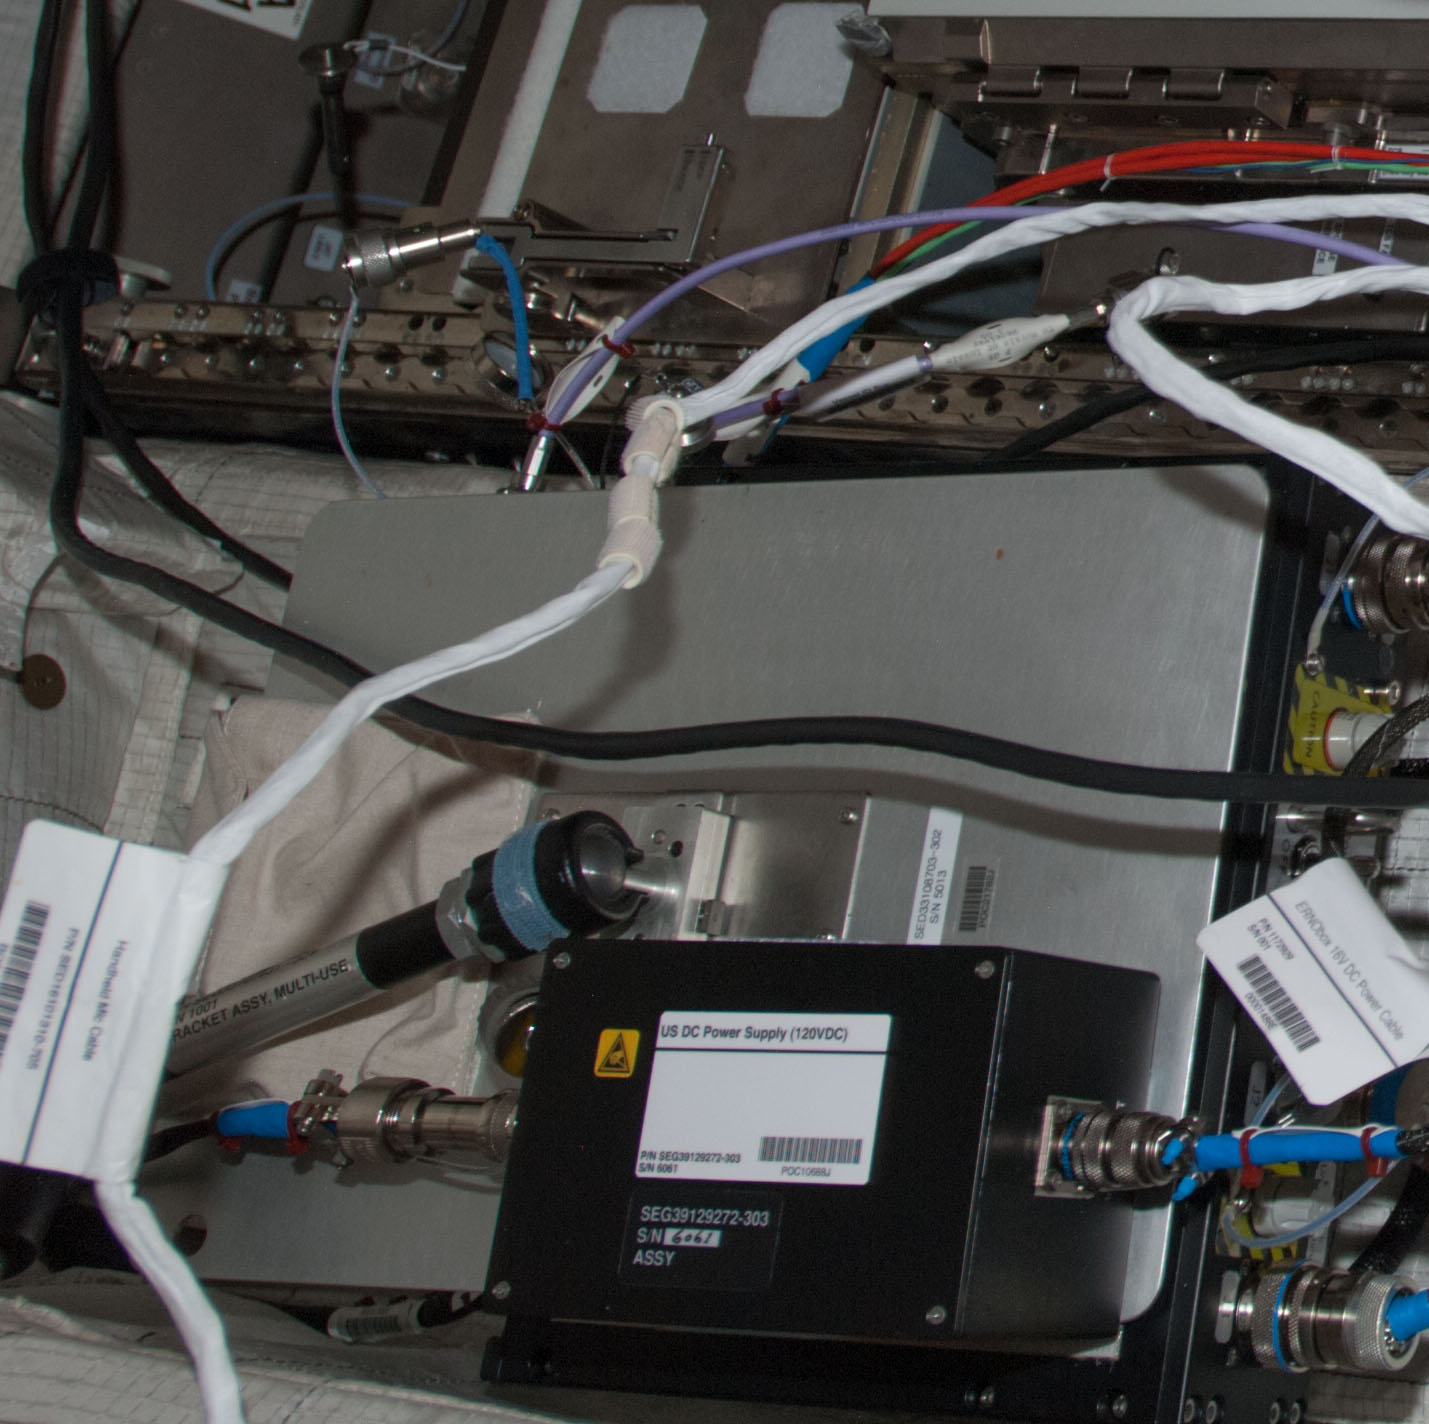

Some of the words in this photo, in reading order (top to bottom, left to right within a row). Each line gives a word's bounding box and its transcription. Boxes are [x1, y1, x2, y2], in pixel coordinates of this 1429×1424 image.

[1303, 689, 1321, 758] CAUTION
[933, 868, 947, 898] 5013
[928, 902, 941, 924] S/N
[1256, 915, 1274, 933] P/N
[61, 926, 80, 953] P/N
[1245, 921, 1263, 940] S/N
[1254, 934, 1273, 953] 001
[96, 938, 128, 1001] Handheld
[1292, 897, 1338, 949] ERNObox
[1340, 961, 1364, 985] DC
[1352, 978, 1386, 1014] Power
[1375, 1007, 1408, 1043] Cable
[170, 1008, 229, 1042] RACKET
[229, 990, 272, 1018] ASSY,
[271, 957, 351, 1000] MULTI-USE
[90, 1000, 110, 1025] Mic
[79, 1023, 103, 1063] Cable
[661, 1026, 678, 1039] US
[681, 1026, 700, 1039] DC
[703, 1027, 742, 1040] Power
[744, 1027, 786, 1042] Supply
[790, 1027, 848, 1043] (120VDC)
[638, 1163, 655, 1173] S/N
[640, 1151, 657, 1161] P/N
[658, 1151, 741, 1163] SEG39129272-303
[640, 1206, 770, 1227] SEG39129272-303
[637, 1228, 663, 1244] S/N
[633, 1250, 676, 1266] ASSY
